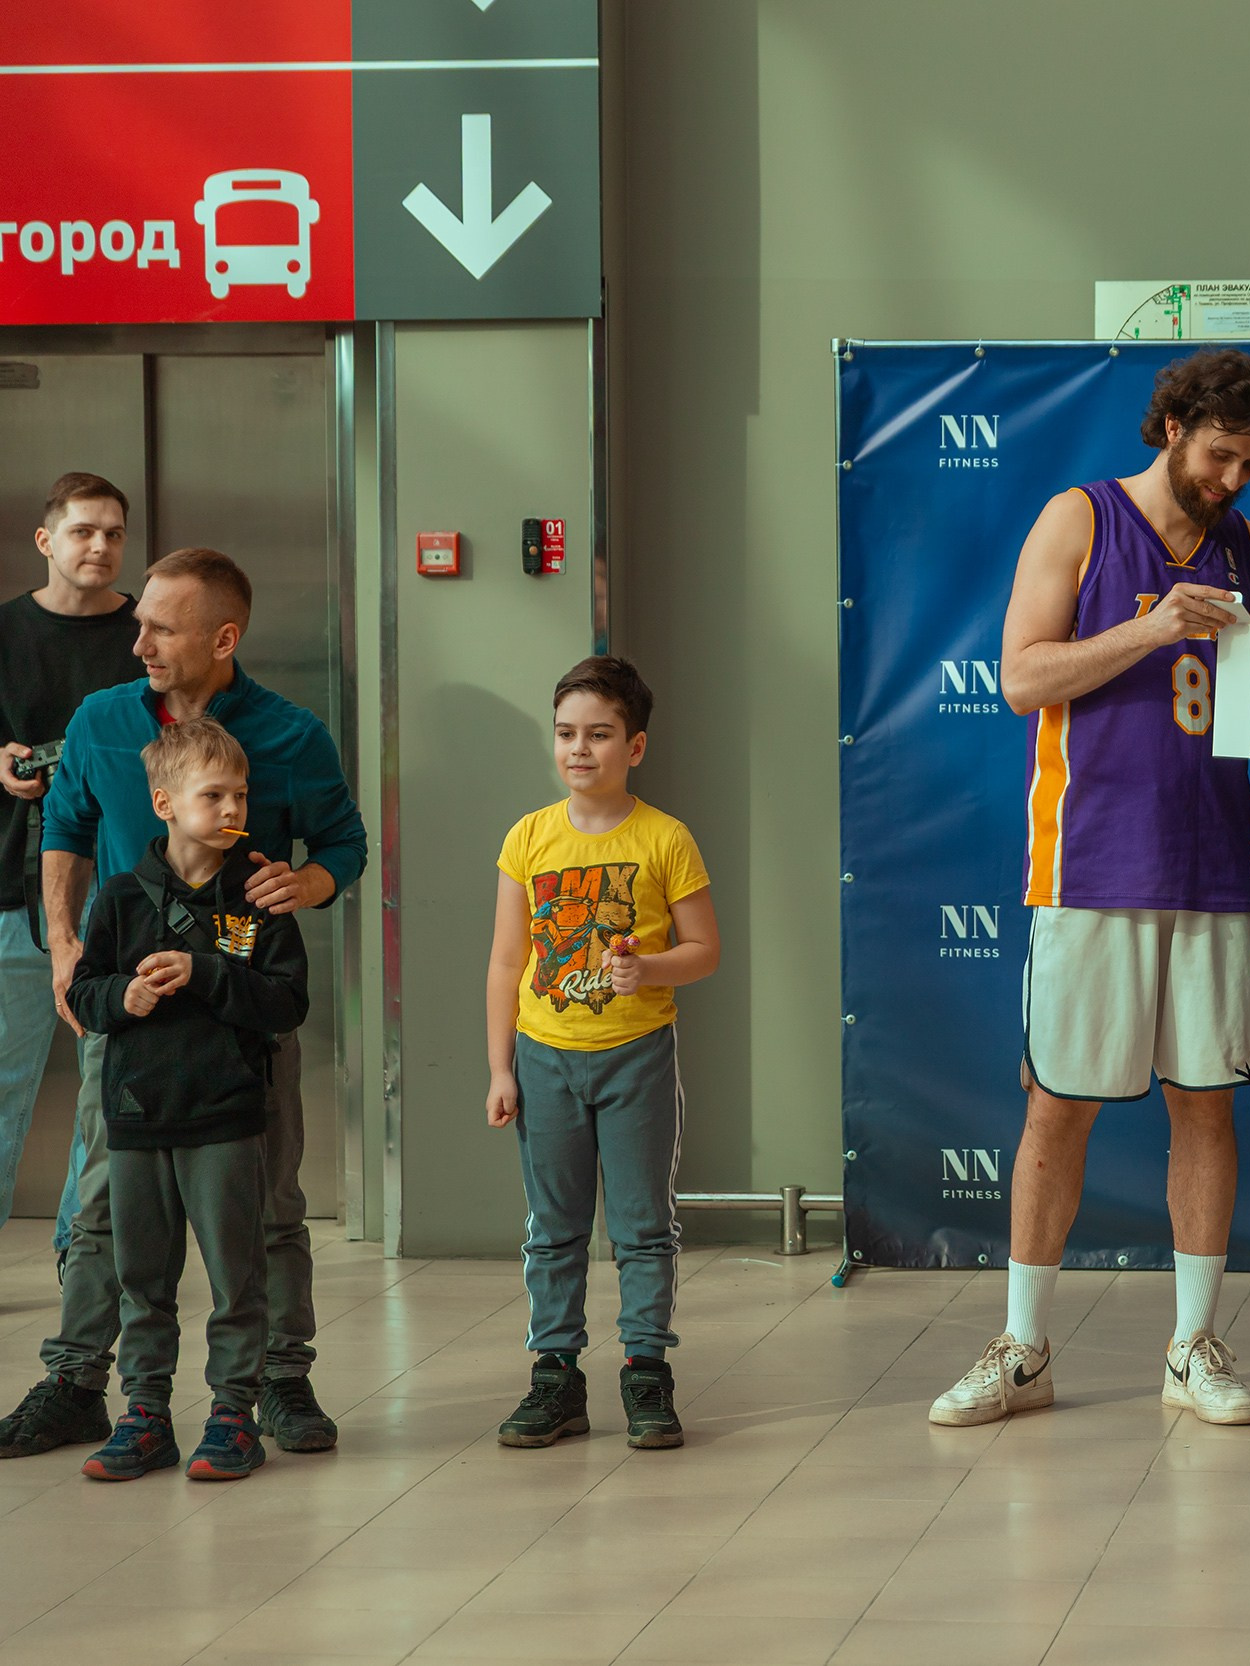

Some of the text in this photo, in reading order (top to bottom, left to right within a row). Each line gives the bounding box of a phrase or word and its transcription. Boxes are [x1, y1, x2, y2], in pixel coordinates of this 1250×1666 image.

[1196, 284, 1220, 292] ПЛАН
[939, 415, 999, 448] NN
[939, 457, 999, 467] FITNESS
[546, 521, 562, 535] 01
[940, 661, 1000, 694] NN
[939, 704, 999, 714] FITNESS
[1171, 653, 1213, 735] 8
[533, 864, 638, 907] BMX
[940, 905, 1000, 939] NN
[940, 948, 1000, 957] FITNESS
[560, 968, 613, 1000] Ride
[941, 1149, 1001, 1182] NN
[942, 1189, 1002, 1199] FITNESS
